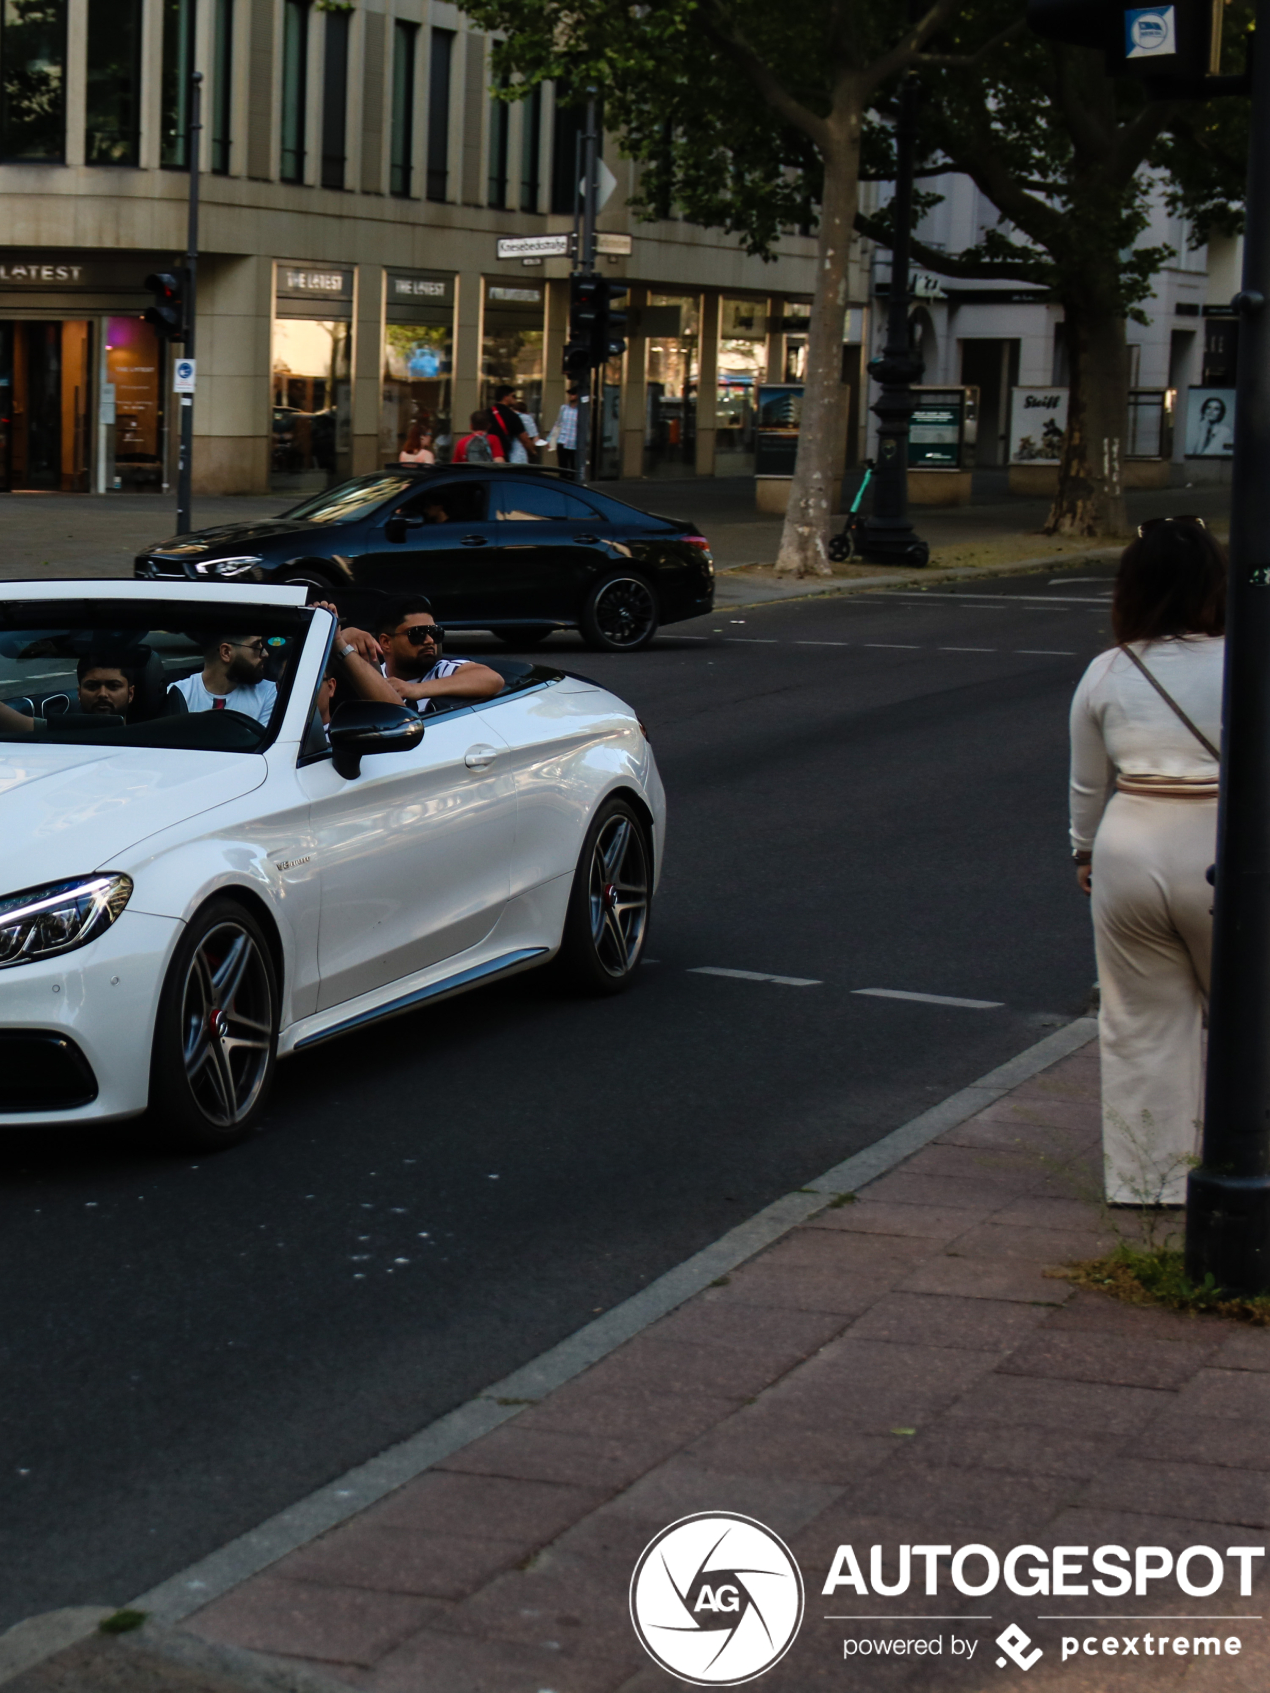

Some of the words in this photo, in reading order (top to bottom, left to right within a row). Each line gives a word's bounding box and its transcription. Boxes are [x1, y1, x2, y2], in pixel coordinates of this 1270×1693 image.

[0, 265, 82, 281] LATEST
[287, 272, 306, 288] THE
[308, 274, 343, 291] LATEST
[395, 279, 413, 294] THE
[414, 281, 445, 297] LATEST
[1023, 395, 1060, 409] Steiff
